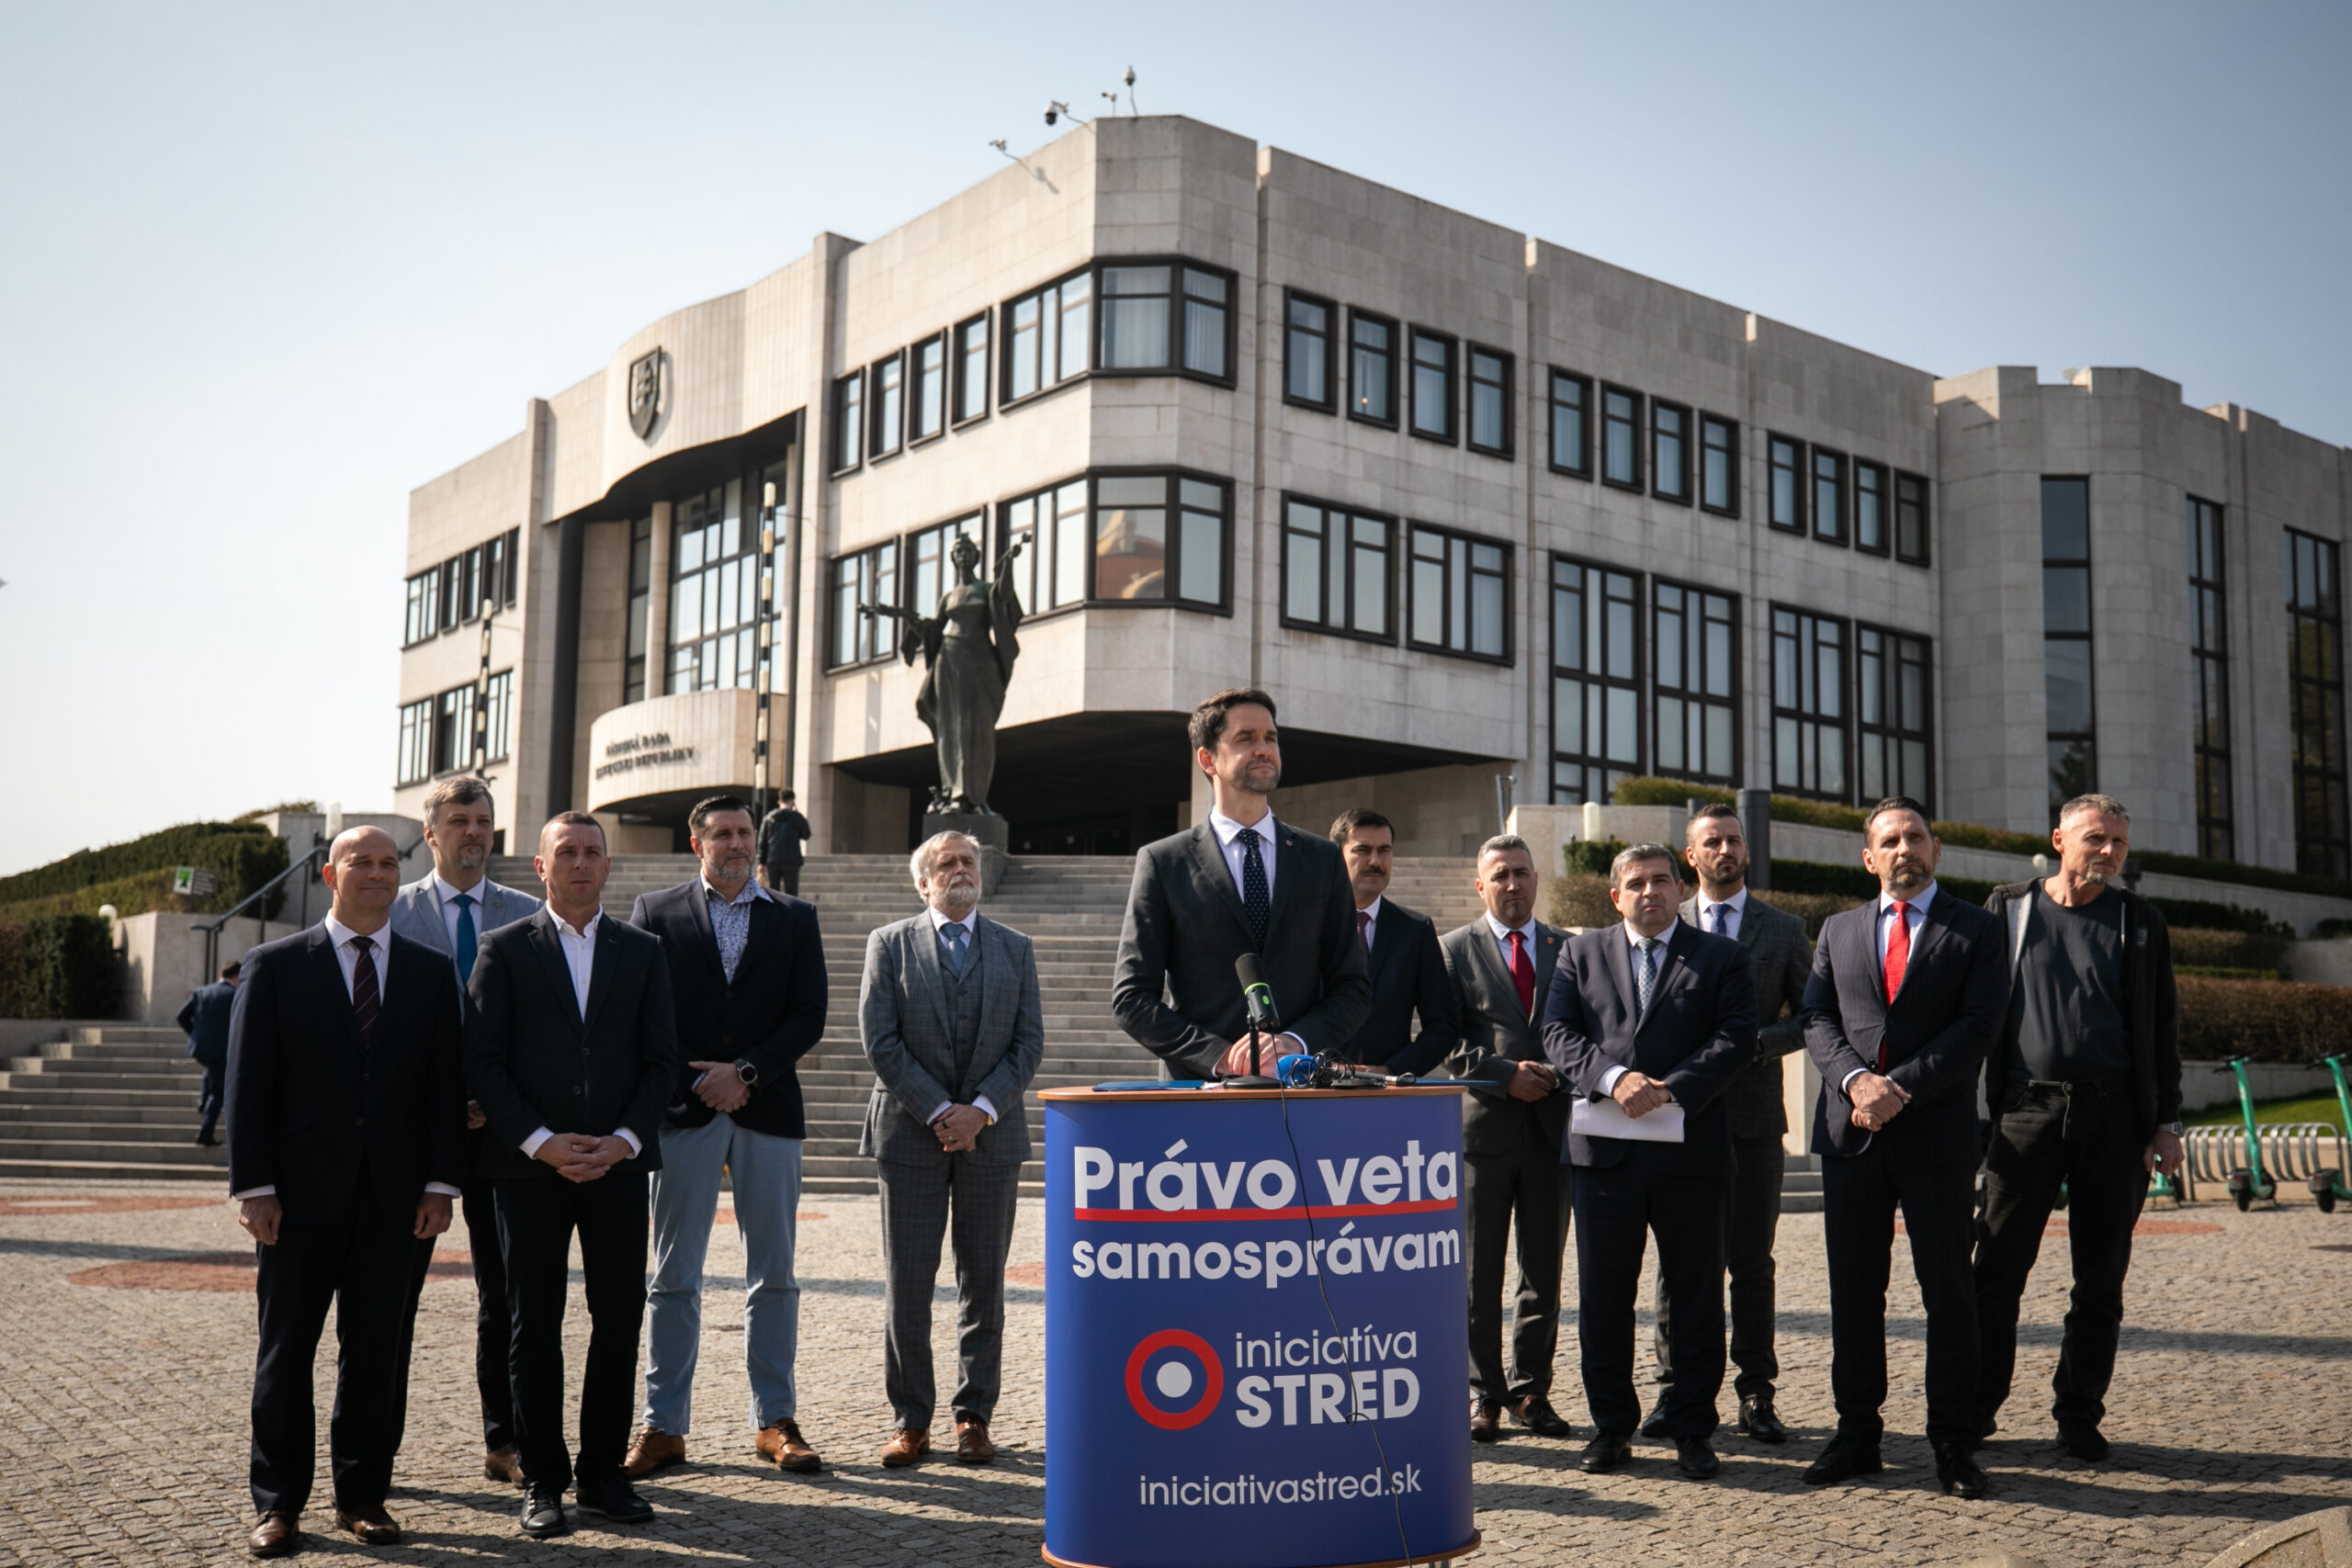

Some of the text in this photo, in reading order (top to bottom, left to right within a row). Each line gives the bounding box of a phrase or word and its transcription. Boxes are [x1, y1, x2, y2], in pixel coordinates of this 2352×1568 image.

[1073, 1138, 1457, 1212] Právo veta
[1073, 1221, 1460, 1288] samosprávam
[1236, 1324, 1417, 1367] iniciatíva
[1236, 1368, 1420, 1427] STRED
[1140, 1463, 1422, 1505] iniciativastred.sk
